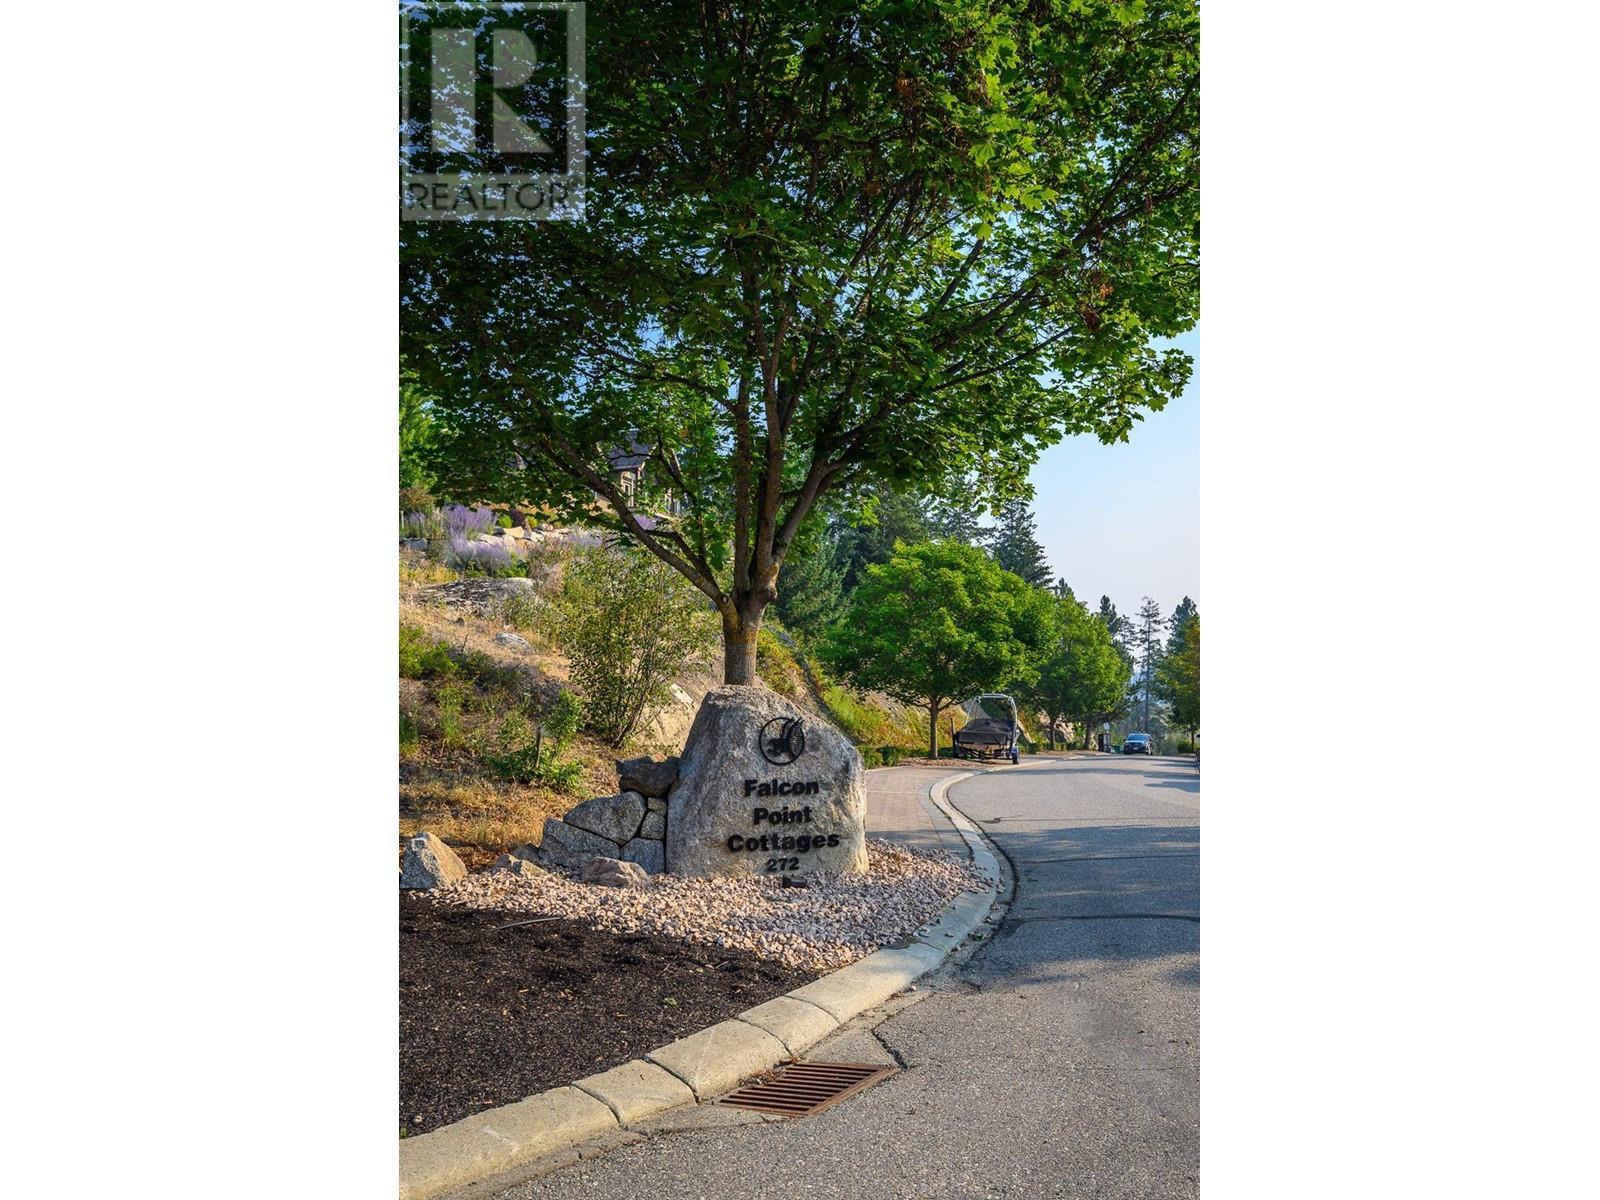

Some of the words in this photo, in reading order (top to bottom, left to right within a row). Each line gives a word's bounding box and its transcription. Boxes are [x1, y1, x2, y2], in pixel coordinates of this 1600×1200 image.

[744, 779, 820, 797] Falcon
[753, 806, 813, 825] Point
[727, 833, 840, 853] Cottages
[765, 857, 800, 872] 272
